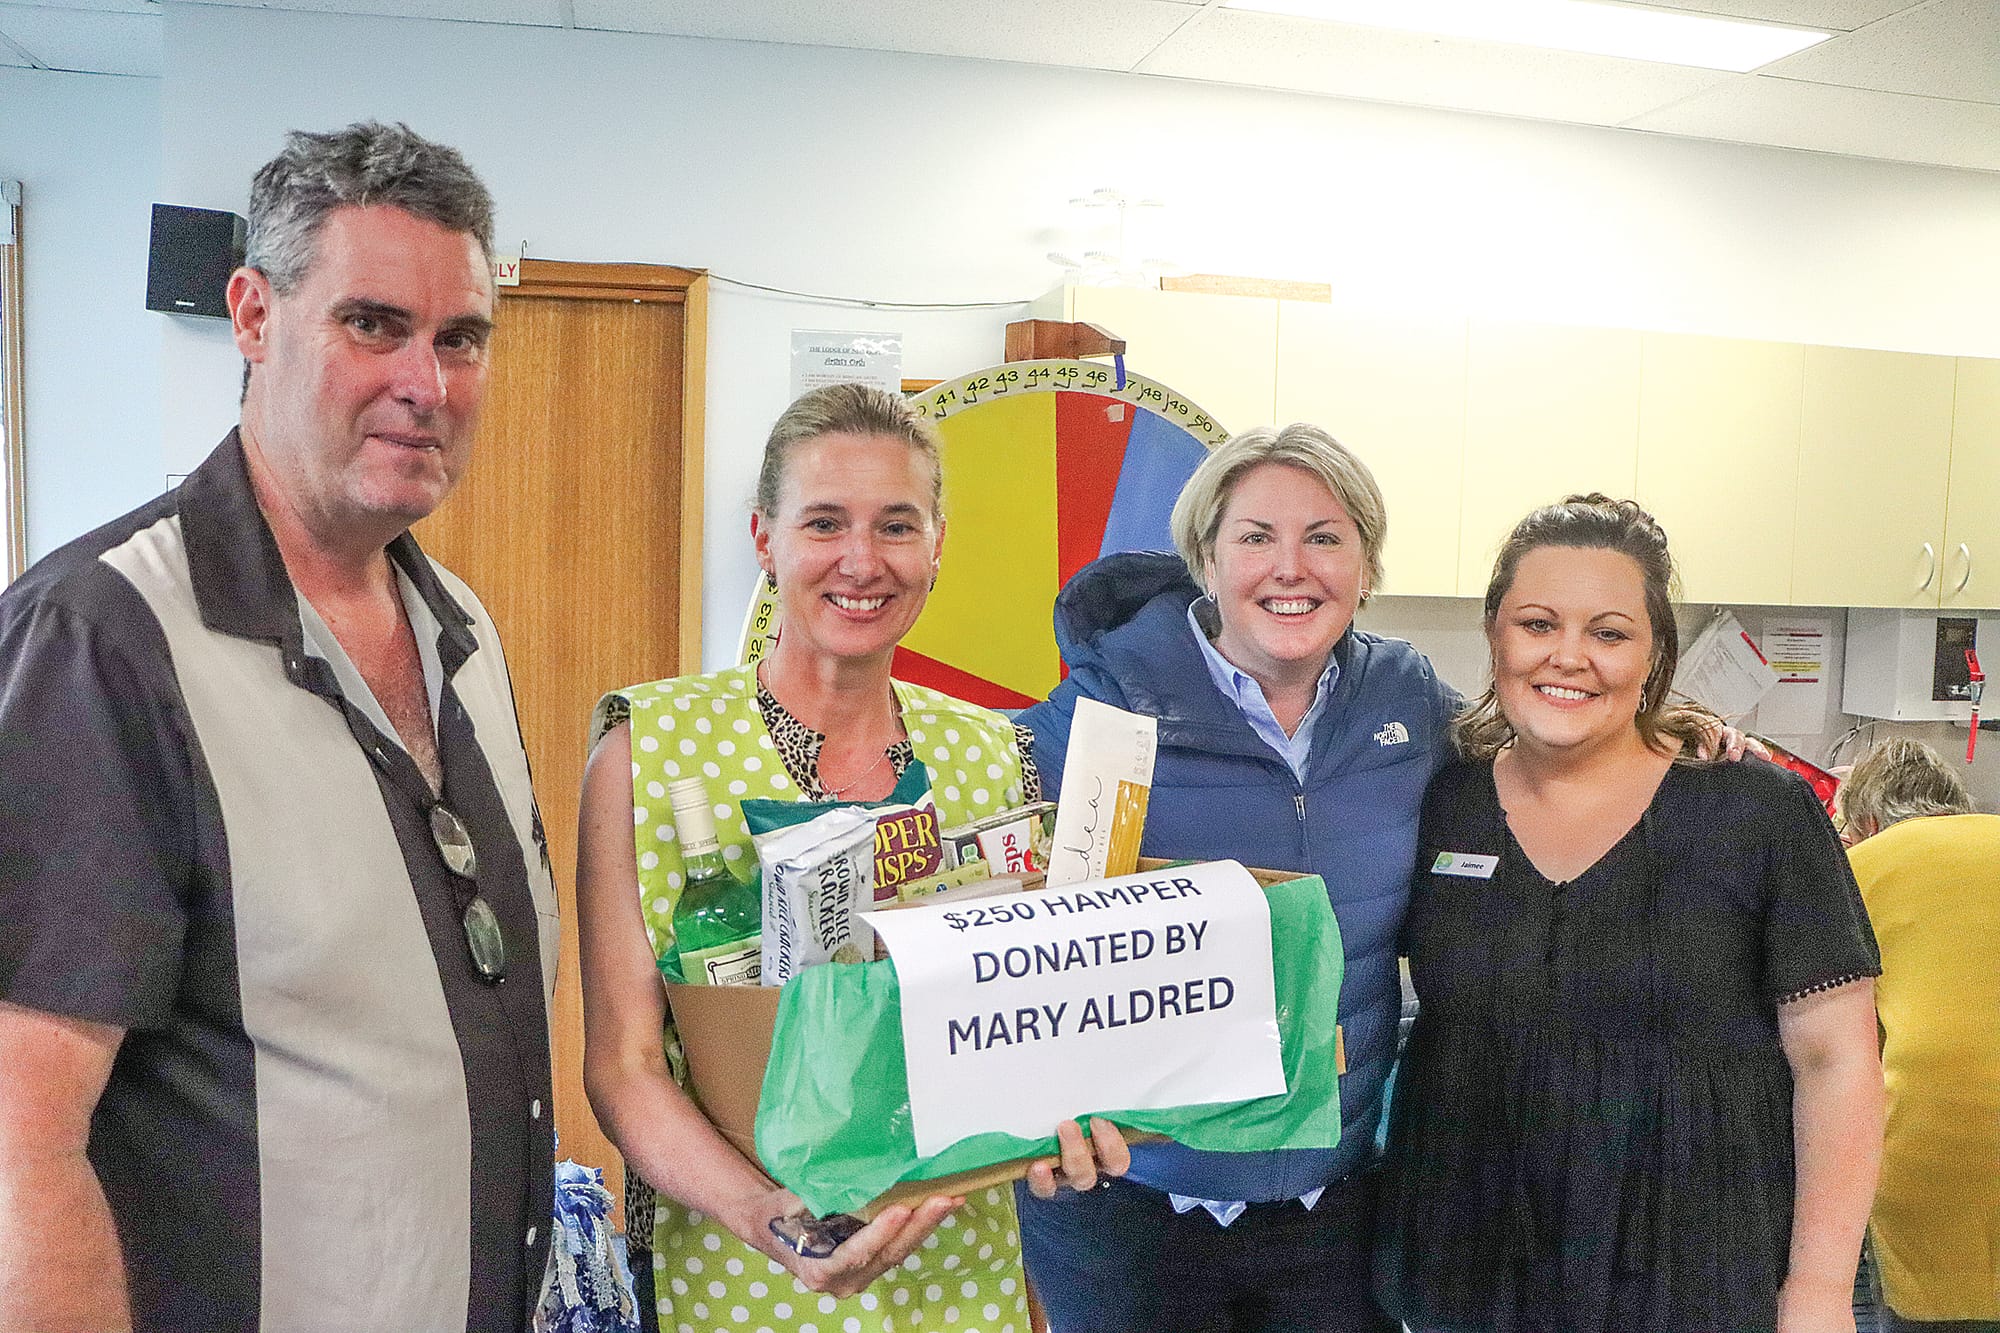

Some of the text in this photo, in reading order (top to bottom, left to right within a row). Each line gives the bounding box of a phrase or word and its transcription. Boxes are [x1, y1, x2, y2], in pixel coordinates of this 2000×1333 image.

[494, 263, 517, 278] LY
[936, 390, 956, 405] 41
[967, 377, 989, 392] 42
[996, 370, 1019, 382] 43
[1027, 367, 1050, 378] 44
[1057, 367, 1079, 378] 45
[1086, 370, 1108, 383] 46
[1143, 387, 1162, 401] 48
[1169, 400, 1188, 415] 49
[1194, 414, 1213, 432] 50
[748, 639, 763, 664] 32
[756, 602, 772, 630] 33
[1461, 861, 1484, 869] Jaimee
[777, 895, 790, 925] RICE
[835, 908, 851, 945] RICE
[942, 877, 1202, 933] $250 HAMPER
[778, 924, 792, 982] CRACKERS
[972, 920, 1208, 984] DONATED BY
[948, 975, 1235, 1056] MARY ALDRED
